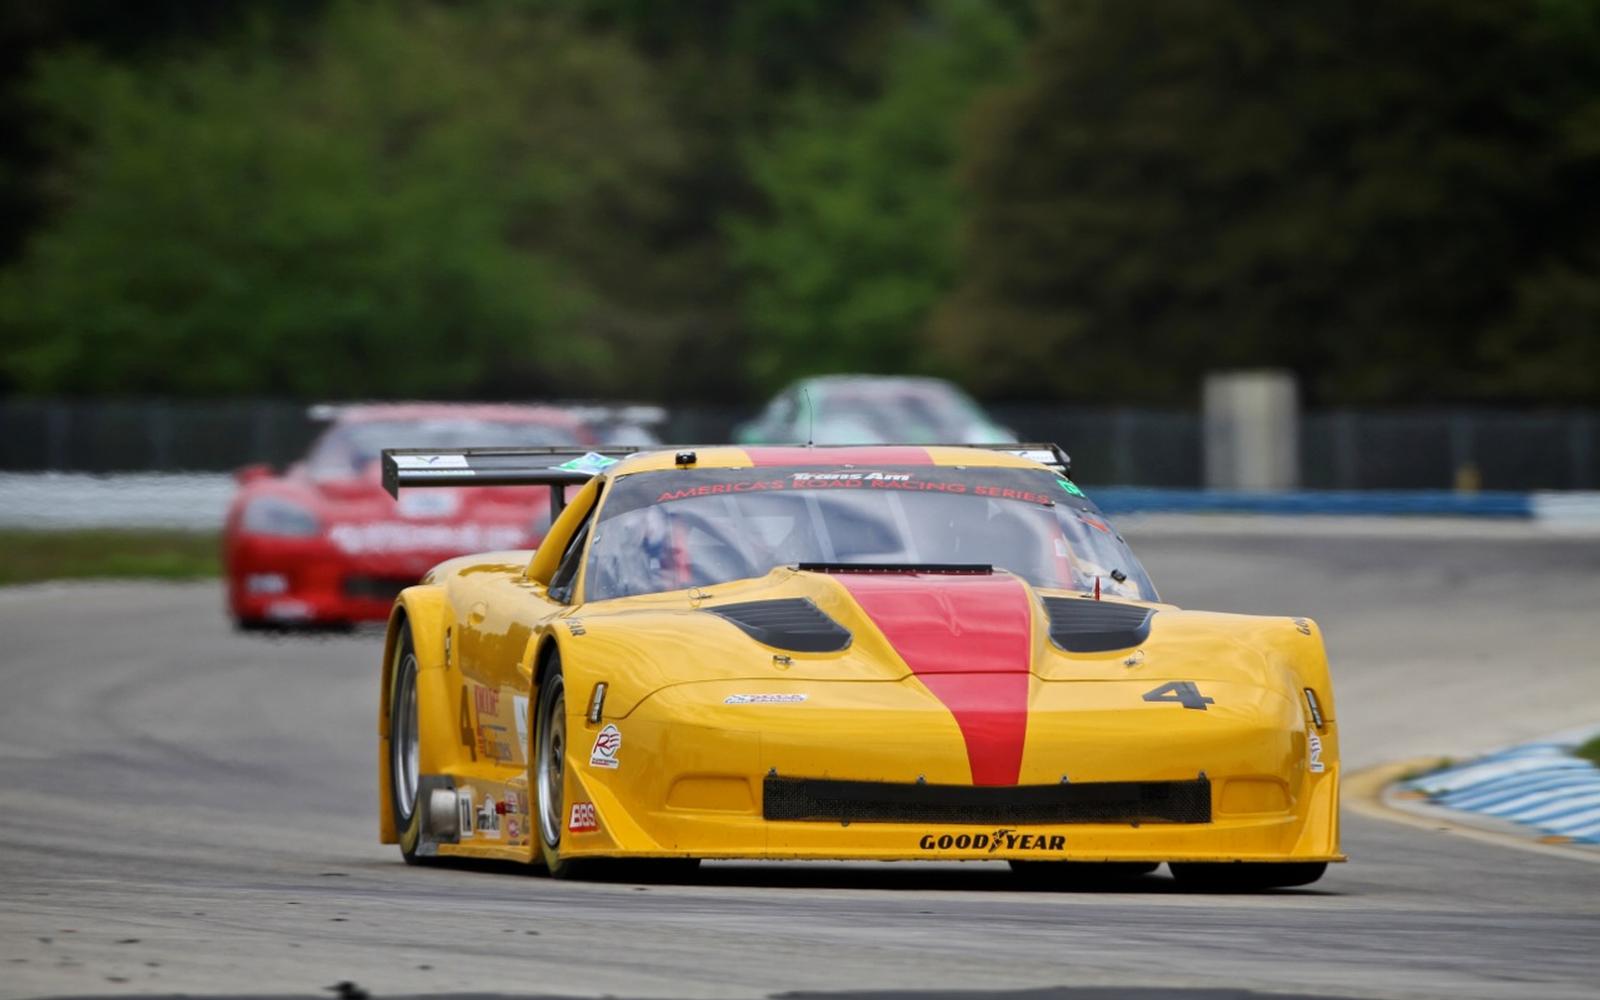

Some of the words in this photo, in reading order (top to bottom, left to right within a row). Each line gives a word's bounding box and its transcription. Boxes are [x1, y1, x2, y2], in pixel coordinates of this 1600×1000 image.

[657, 479, 786, 502] AMERICA'S
[792, 479, 863, 489] ROAD
[871, 479, 966, 493] RACING
[974, 486, 1051, 505] SERIES
[1142, 681, 1215, 710] 4
[569, 803, 597, 828] BBS
